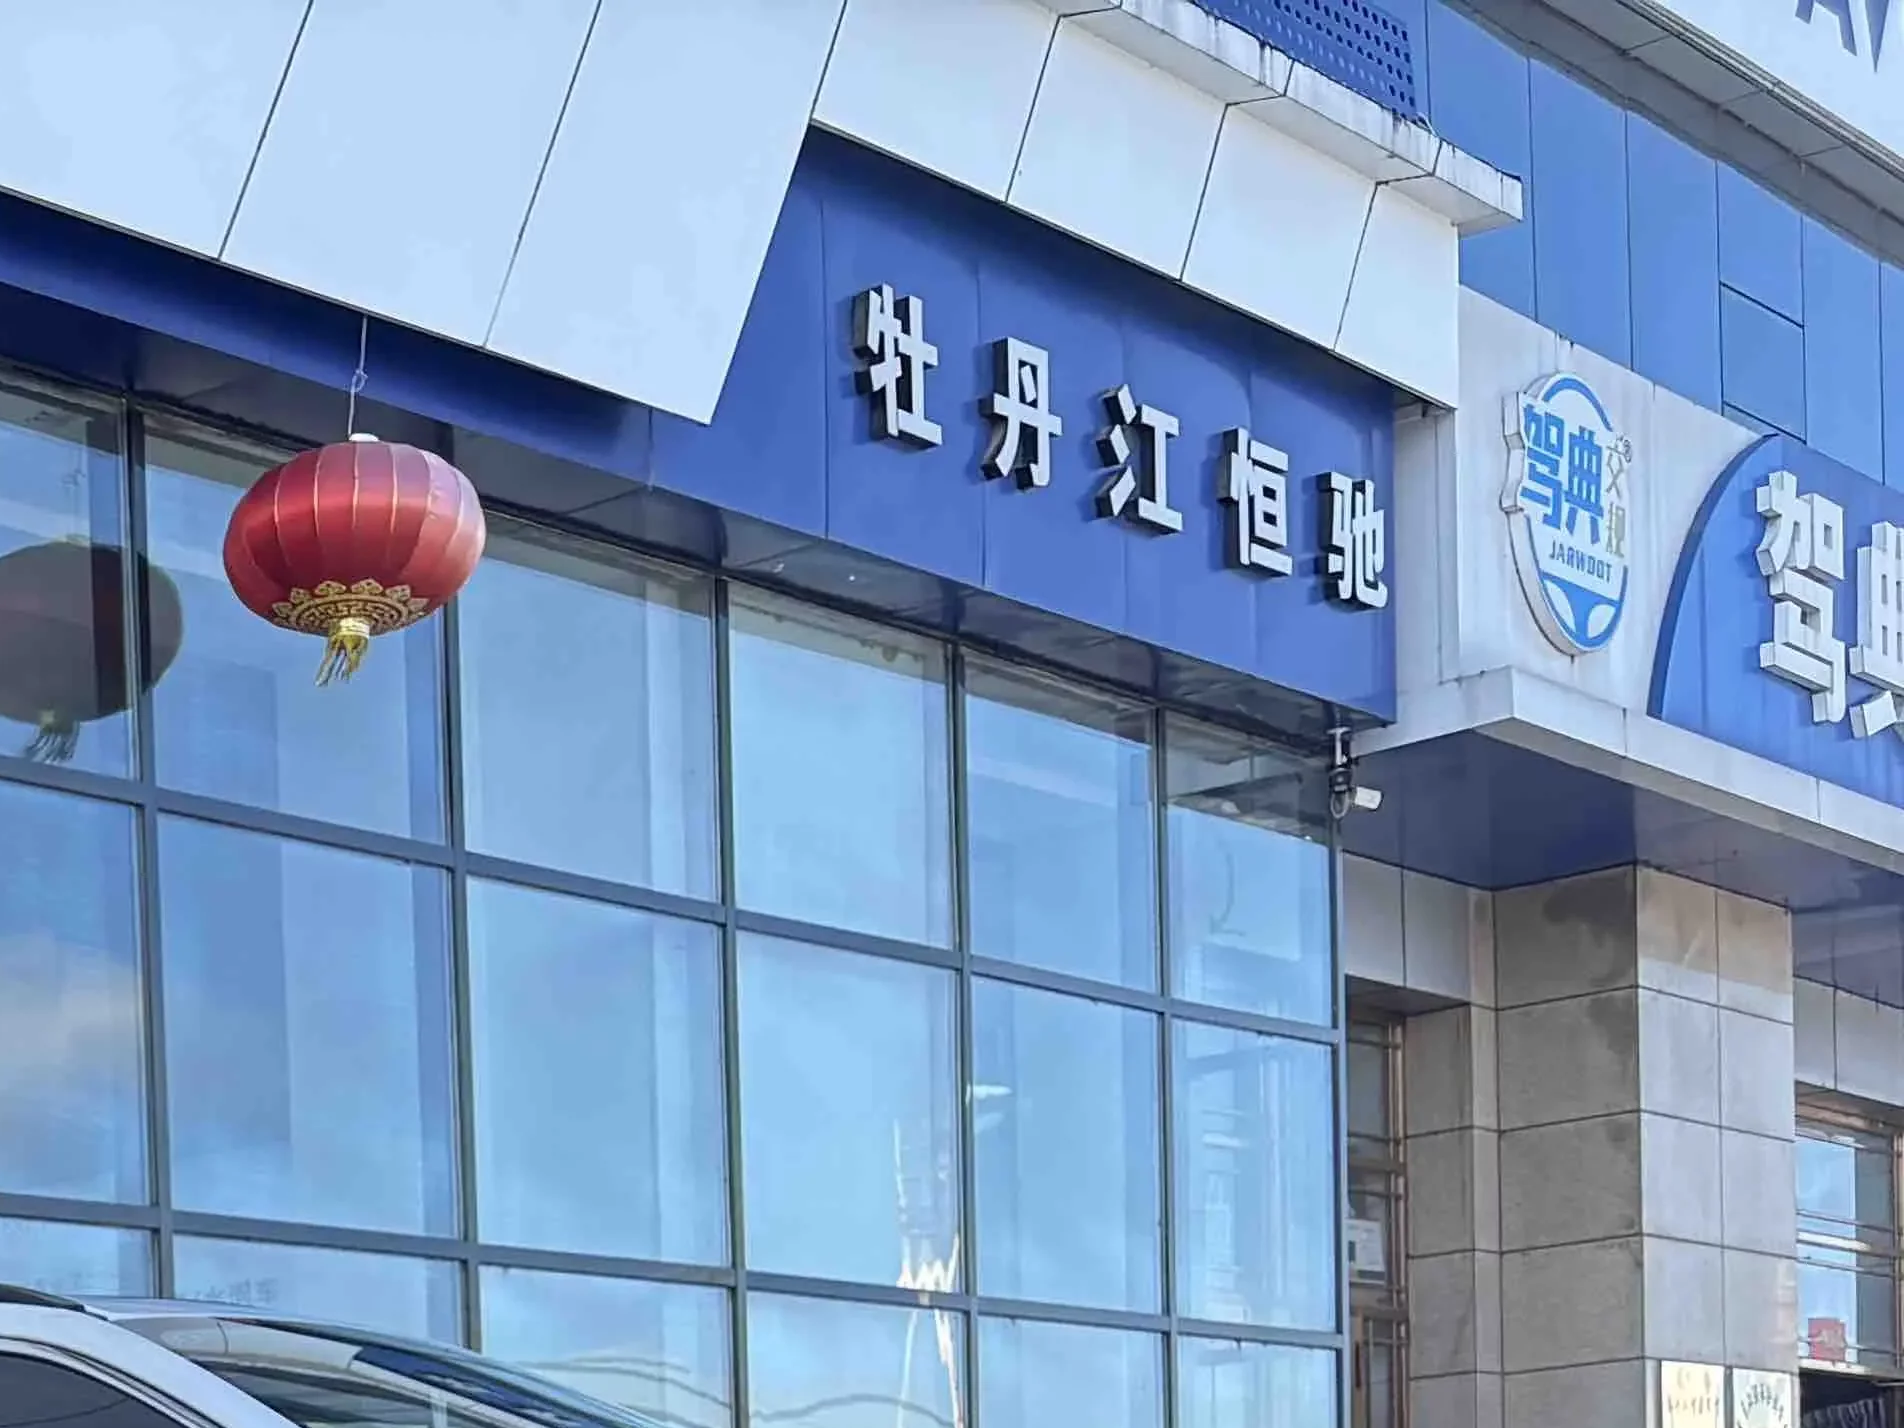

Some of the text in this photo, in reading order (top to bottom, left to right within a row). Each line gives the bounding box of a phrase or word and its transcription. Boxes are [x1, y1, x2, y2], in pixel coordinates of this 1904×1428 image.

[854, 282, 1388, 608] 牡丹江恒驰
[1519, 403, 1604, 546] 驾典
